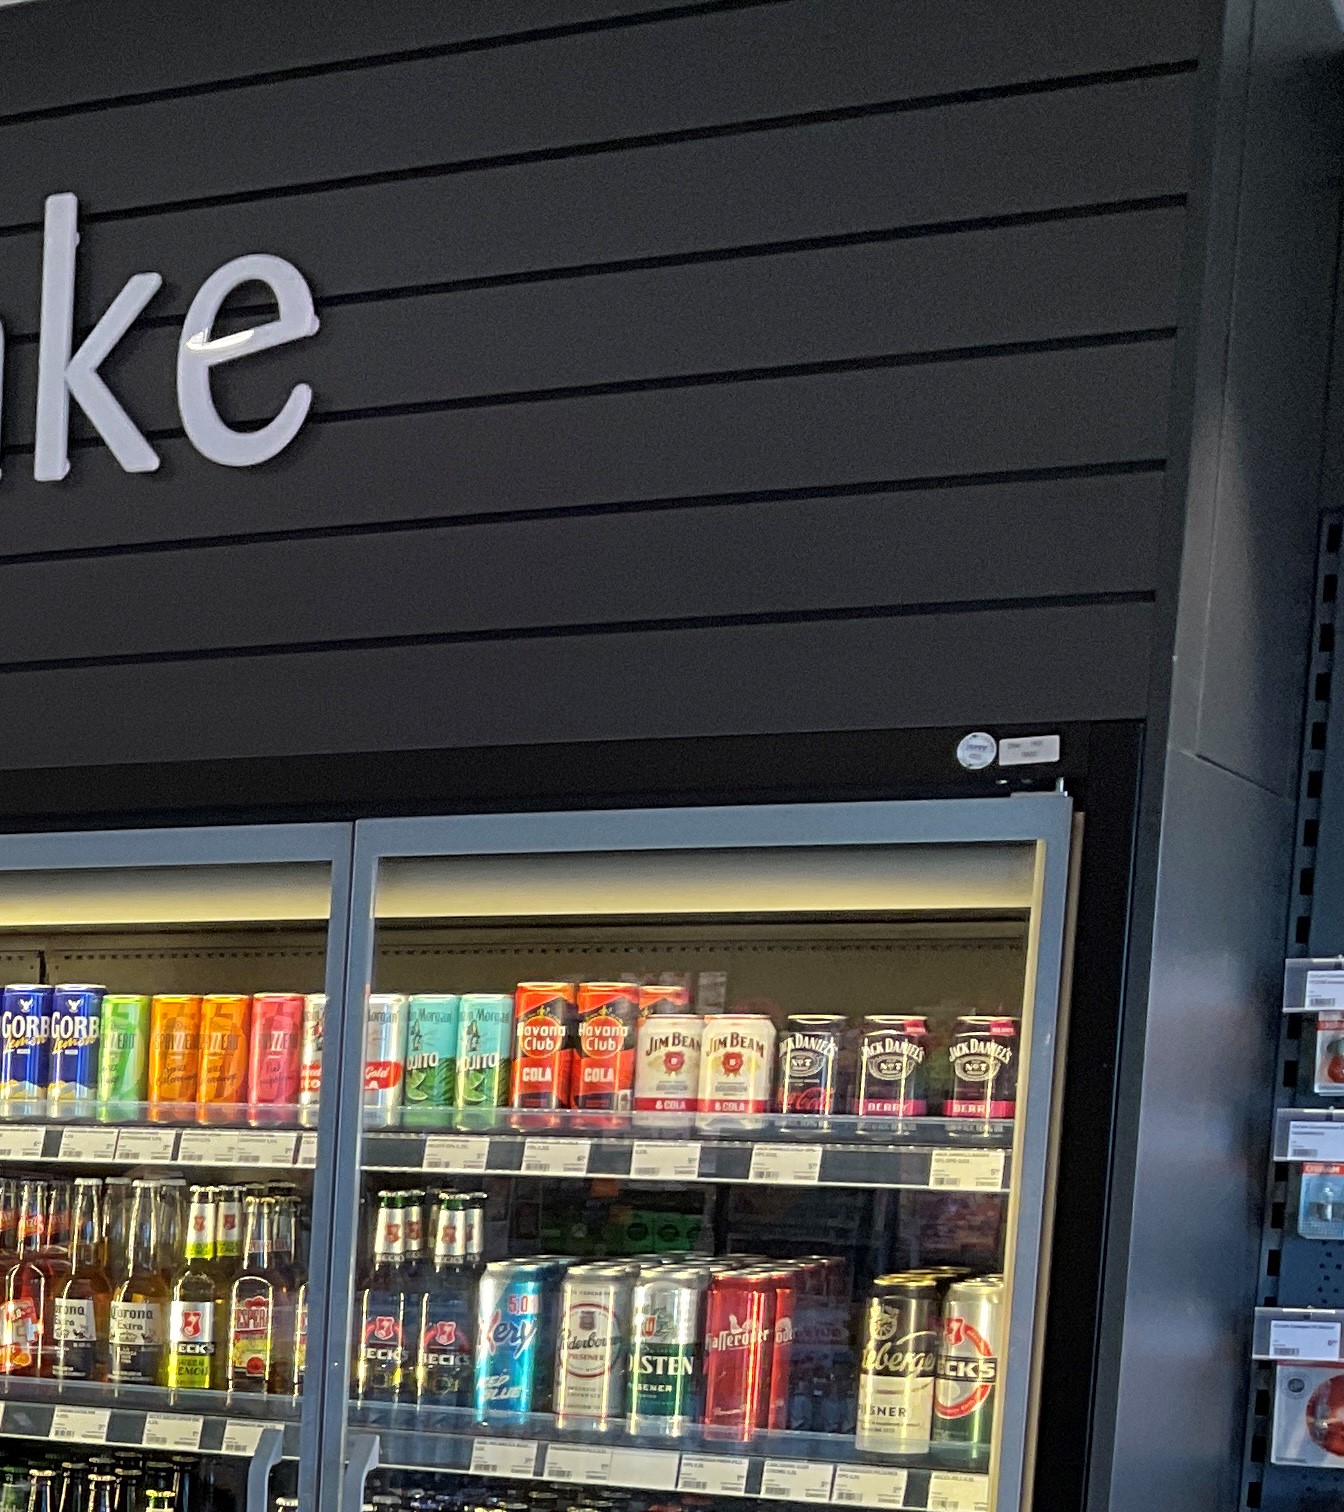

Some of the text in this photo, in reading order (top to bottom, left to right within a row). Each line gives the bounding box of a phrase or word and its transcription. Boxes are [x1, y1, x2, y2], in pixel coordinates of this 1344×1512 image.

[517, 1022, 566, 1036] Havana
[579, 1024, 628, 1037] Havana
[524, 1037, 554, 1051] Club
[586, 1038, 616, 1051] Club
[648, 1035, 670, 1056] JIM
[709, 1031, 765, 1057] JIM BEAM
[523, 1067, 552, 1082] COLA
[584, 1067, 614, 1082] COLA
[664, 1100, 686, 1111] COLA
[723, 1103, 745, 1112] COLA
[953, 1104, 991, 1114] BERR
[112, 1305, 153, 1319] Corona
[117, 1321, 142, 1331] Extra
